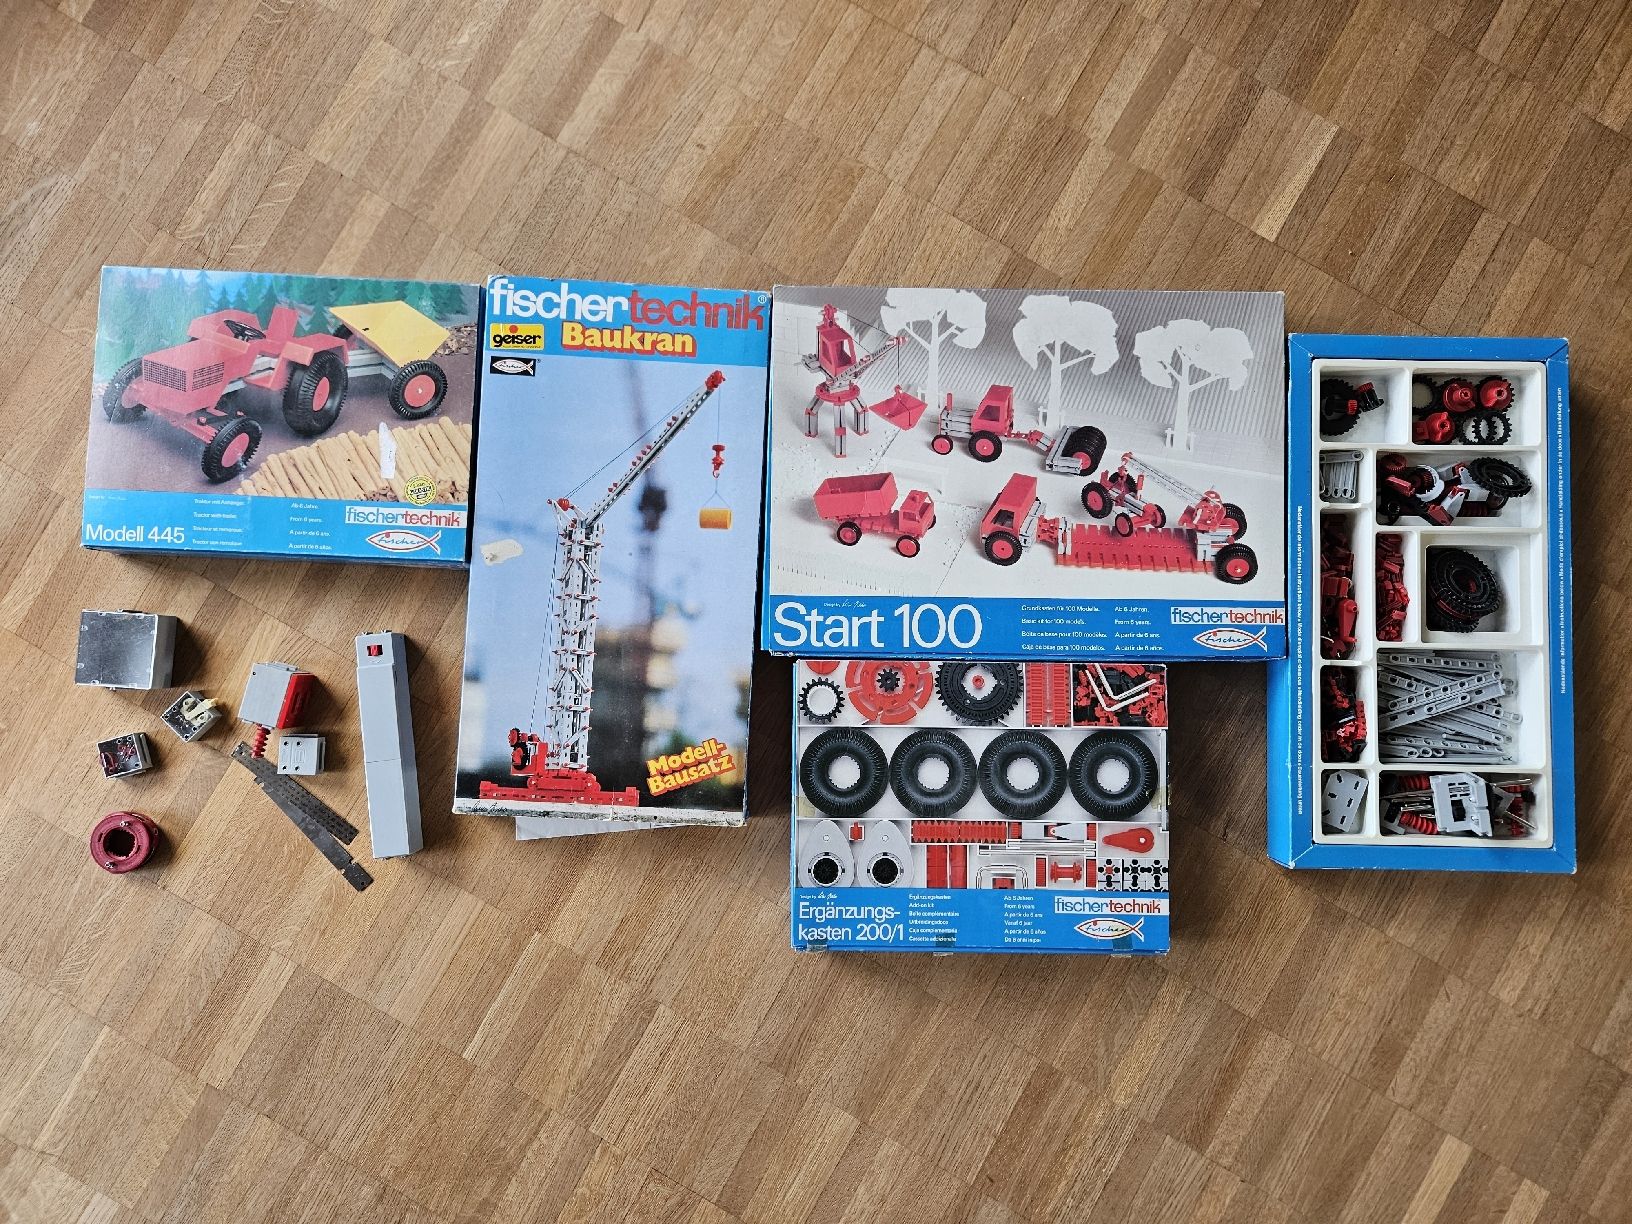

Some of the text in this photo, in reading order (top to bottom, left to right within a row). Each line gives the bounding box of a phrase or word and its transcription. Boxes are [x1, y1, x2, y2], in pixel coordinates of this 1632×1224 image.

[490, 279, 766, 331] fischertechnik
[493, 327, 541, 348] geiser
[562, 321, 697, 357] Baukran
[347, 507, 460, 527] fischertechnik
[86, 524, 185, 544] Modell 445
[377, 533, 425, 546] fischer
[774, 601, 983, 648] Start 100
[1172, 608, 1284, 624] fischertechnik
[647, 738, 727, 776] Modell-
[646, 754, 737, 796] Bausatz
[799, 902, 900, 923] Ergänzungs-
[1055, 898, 1161, 914] fischertechnik
[798, 924, 904, 943] kasten 200/1
